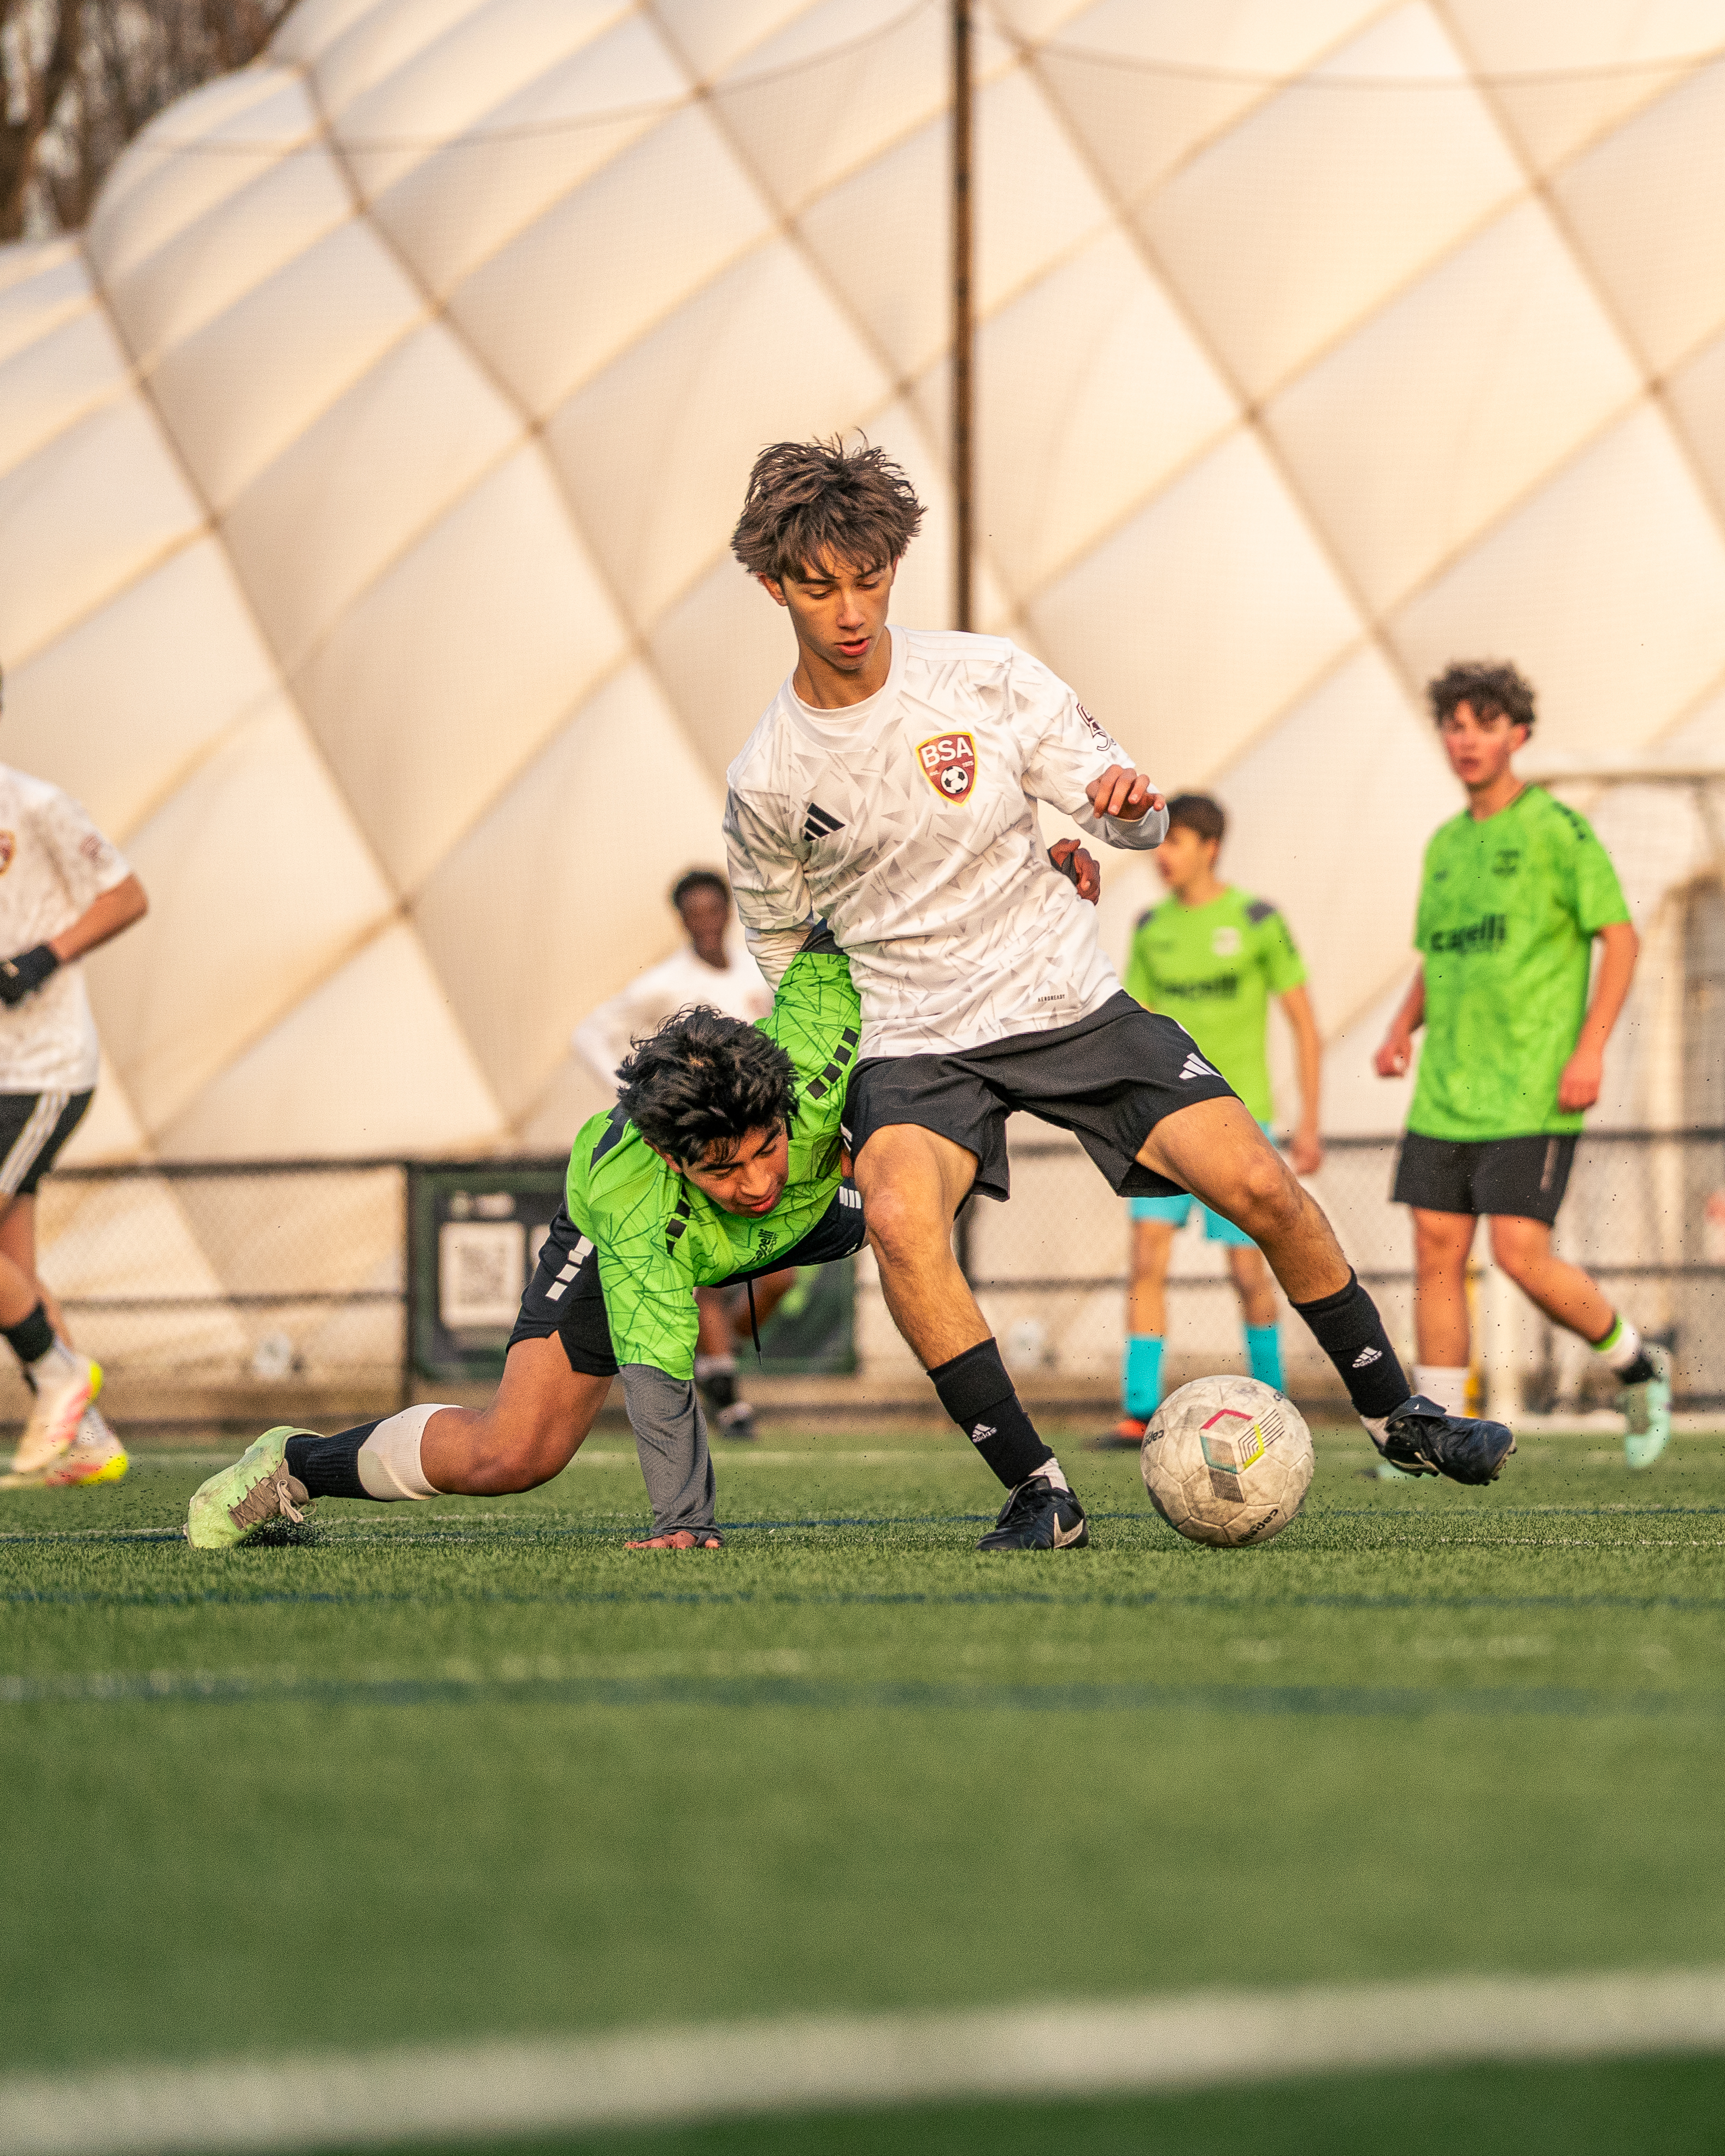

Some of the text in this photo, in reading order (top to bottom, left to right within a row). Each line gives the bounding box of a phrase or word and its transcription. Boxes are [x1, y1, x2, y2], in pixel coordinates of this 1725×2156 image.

[921, 737, 973, 768] BSA
[1352, 1350, 1382, 1368] adidas
[972, 1427, 998, 1443] adidas
